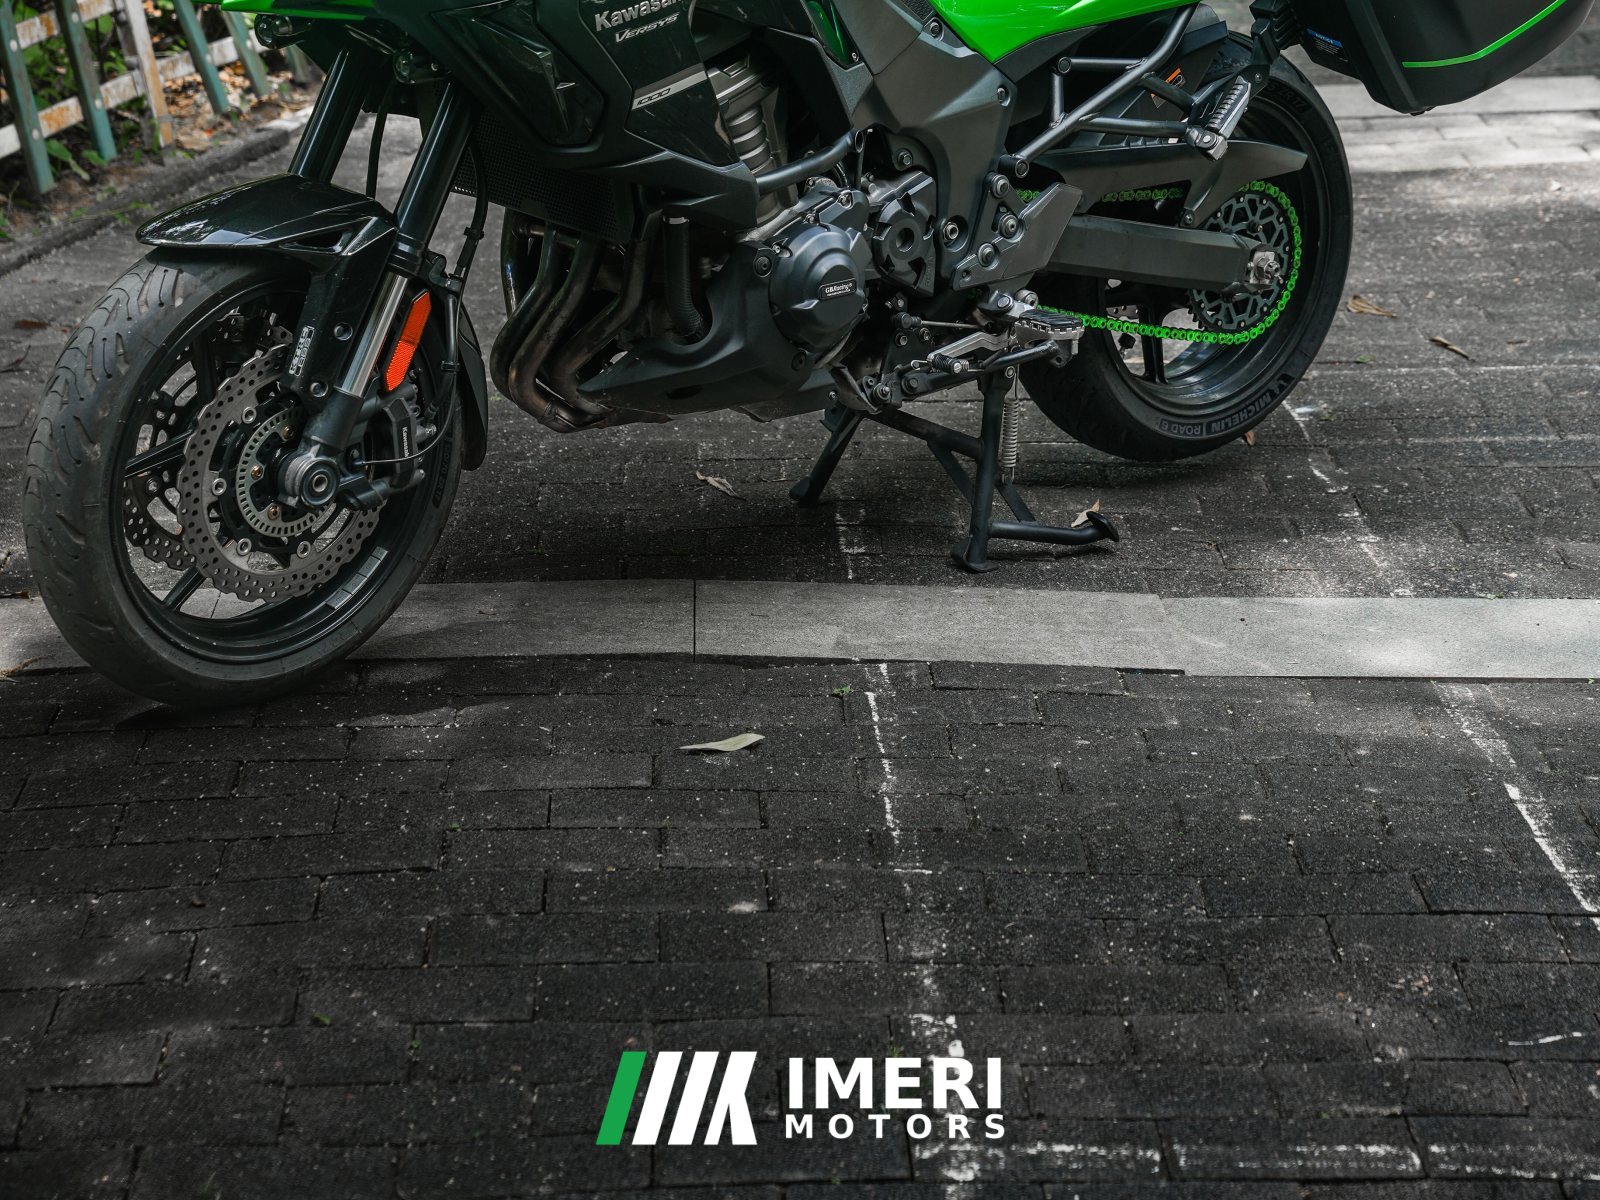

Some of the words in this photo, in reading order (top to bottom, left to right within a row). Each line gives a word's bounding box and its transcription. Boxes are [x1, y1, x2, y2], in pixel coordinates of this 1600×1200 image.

[637, 88, 671, 105] 1000
[1211, 392, 1272, 432] MICHELIN
[1171, 422, 1201, 435] ROAD
[402, 426, 410, 458] Kawasak
